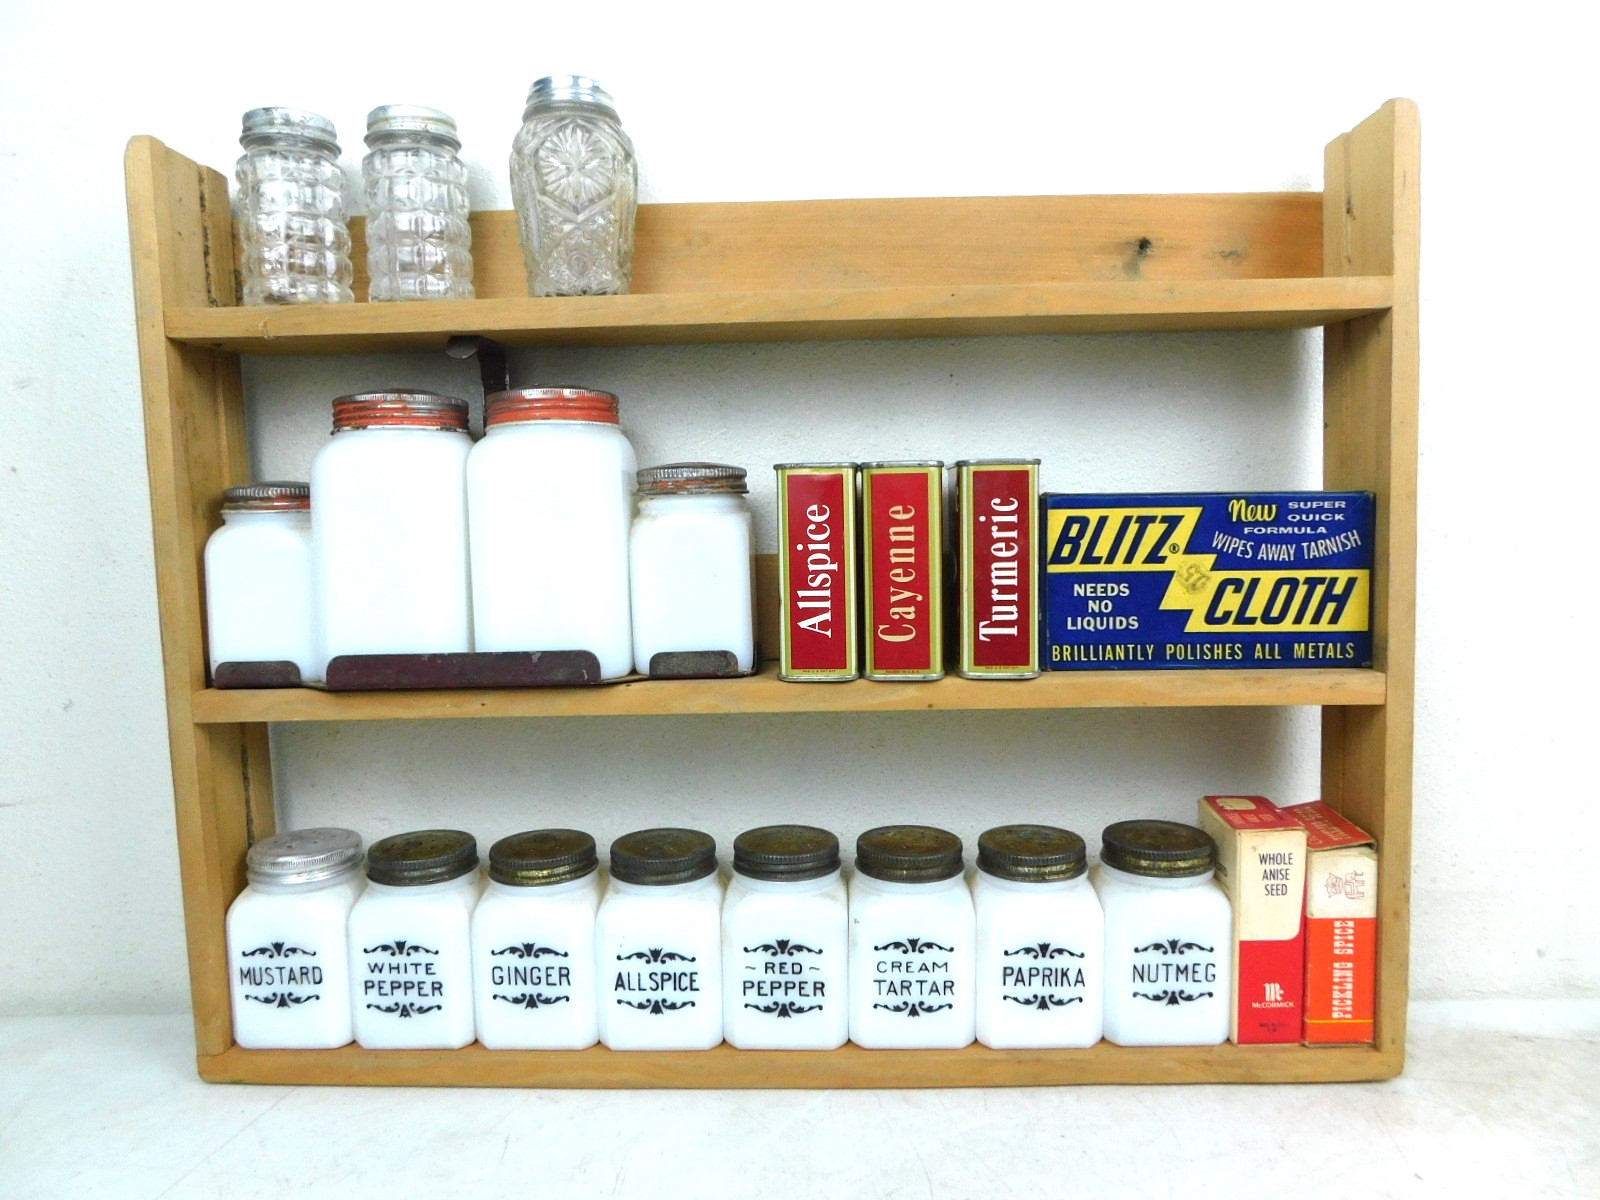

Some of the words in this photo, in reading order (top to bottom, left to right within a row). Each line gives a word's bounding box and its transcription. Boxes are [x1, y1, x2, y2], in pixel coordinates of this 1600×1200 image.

[1228, 499, 1278, 523] New
[1288, 501, 1346, 510] SUPER
[1288, 512, 1345, 522] QUICK
[1243, 526, 1328, 535] FORMULA
[1212, 531, 1255, 560] WIPES
[1257, 543, 1297, 562] AWAY
[1303, 530, 1362, 560] TARNISH
[797, 503, 838, 639] Allspice
[877, 504, 923, 643] Cayenne
[979, 497, 1019, 642] Turmeric
[1073, 583, 1130, 597] NEEDS
[1088, 600, 1113, 613] NO
[1204, 577, 1359, 626] CLOTH
[1067, 616, 1139, 631] LIQUIDS
[1052, 644, 1154, 662] BRILLIANTLY
[1166, 643, 1243, 661] POLISHES
[1254, 643, 1282, 660] ALL
[1293, 642, 1356, 660] METALS
[1258, 852, 1294, 866] WHOLE
[1262, 868, 1290, 881] ANISE
[1264, 884, 1288, 897] SEED
[1333, 920, 1356, 955] SPICE
[240, 966, 323, 986] MUSTARD
[367, 962, 437, 976] WHITE
[491, 965, 571, 987] GINGER
[876, 961, 949, 974] CREAM
[1002, 966, 1086, 988] PAPRIKA
[1132, 963, 1217, 984] NUTMEG
[363, 980, 443, 998] PEPPER
[614, 971, 700, 992] ALLSPICE
[743, 980, 826, 997] PEPPER
[873, 979, 956, 997] TARTAR
[1332, 962, 1354, 1019] PICKLING
